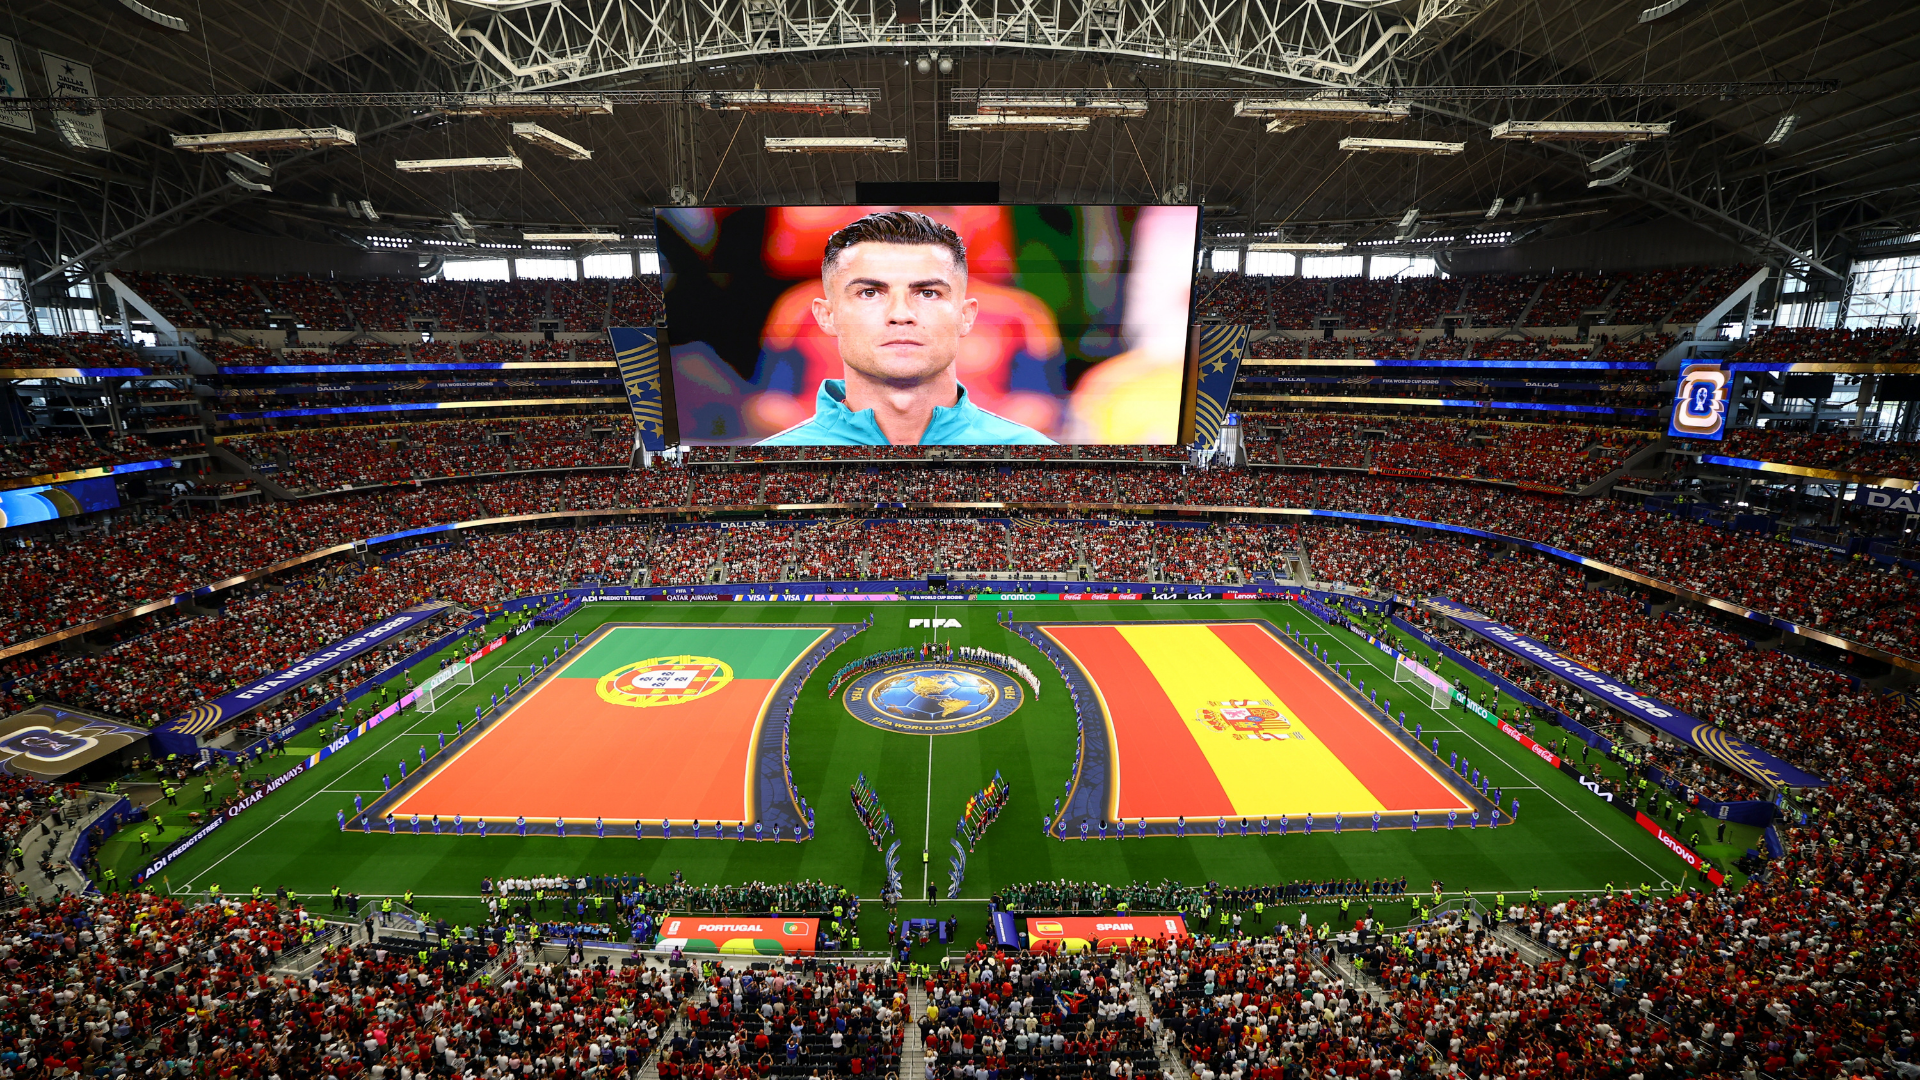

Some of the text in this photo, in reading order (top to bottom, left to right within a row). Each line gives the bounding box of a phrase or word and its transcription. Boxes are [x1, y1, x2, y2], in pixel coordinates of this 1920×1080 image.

[58, 74, 84, 86] DALLAS
[68, 118, 94, 129] WORLD
[909, 619, 962, 628] FIFA
[1422, 634, 1430, 642] FIFA
[1380, 641, 1392, 655] VISA
[236, 616, 413, 699] FIFA WORLD CUP 2026
[1484, 626, 1517, 642] FIFA
[1513, 640, 1572, 668] WORLD
[1565, 667, 1605, 684] CUP
[1596, 684, 1673, 718] 2026
[850, 687, 865, 702] FIFA
[1004, 686, 1016, 700] FIFA
[873, 716, 894, 726] FIFA
[958, 715, 992, 728] 2026
[281, 725, 296, 737] FIFA
[1502, 724, 1521, 742] Coca-Cola
[329, 734, 350, 753] VISA
[1532, 744, 1553, 763] Coca-Cola
[228, 763, 304, 817] QATAR AIRWAYS
[145, 816, 223, 879] ADI PREDICTSTREET
[1658, 829, 1695, 864] Lenovo
